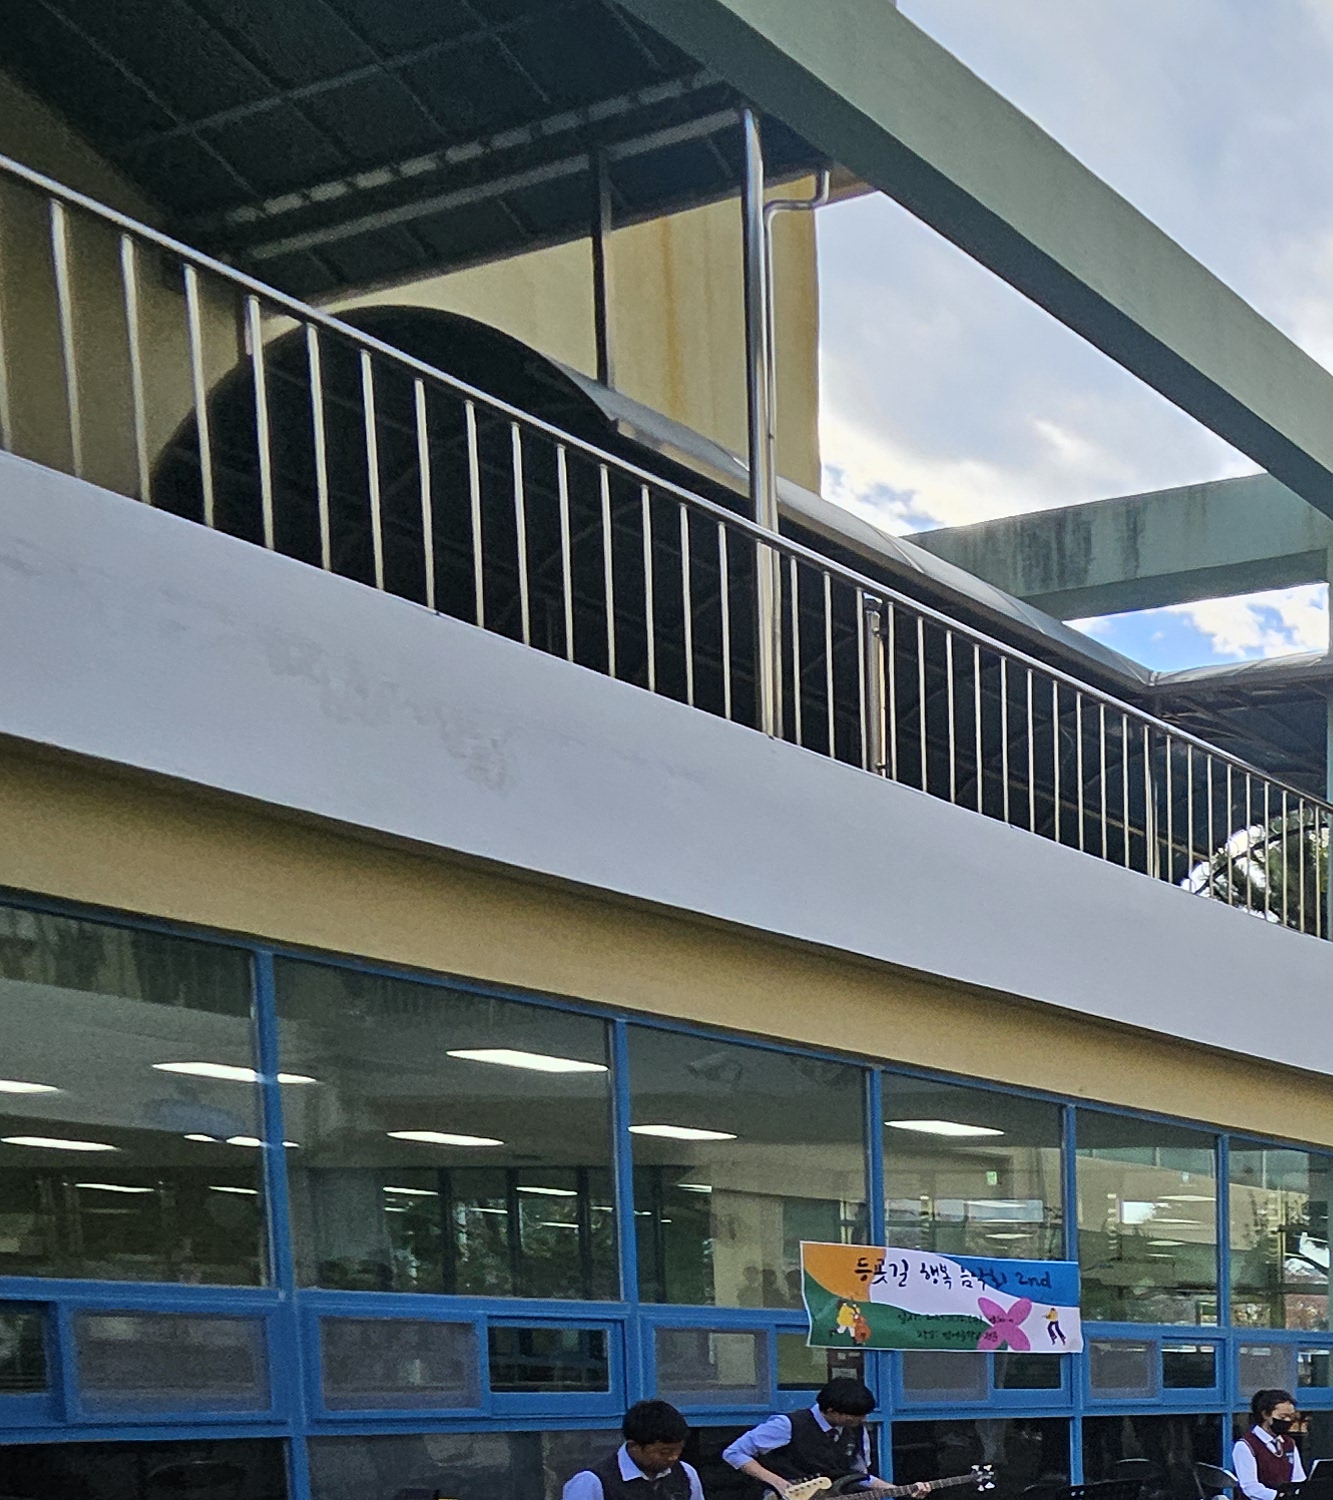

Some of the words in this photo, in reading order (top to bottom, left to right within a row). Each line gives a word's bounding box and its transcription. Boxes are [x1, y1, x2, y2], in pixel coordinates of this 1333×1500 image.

[854, 1257, 909, 1287] 등굣길
[920, 1262, 952, 1290] 행복
[1015, 1271, 1052, 1289] 2nd
